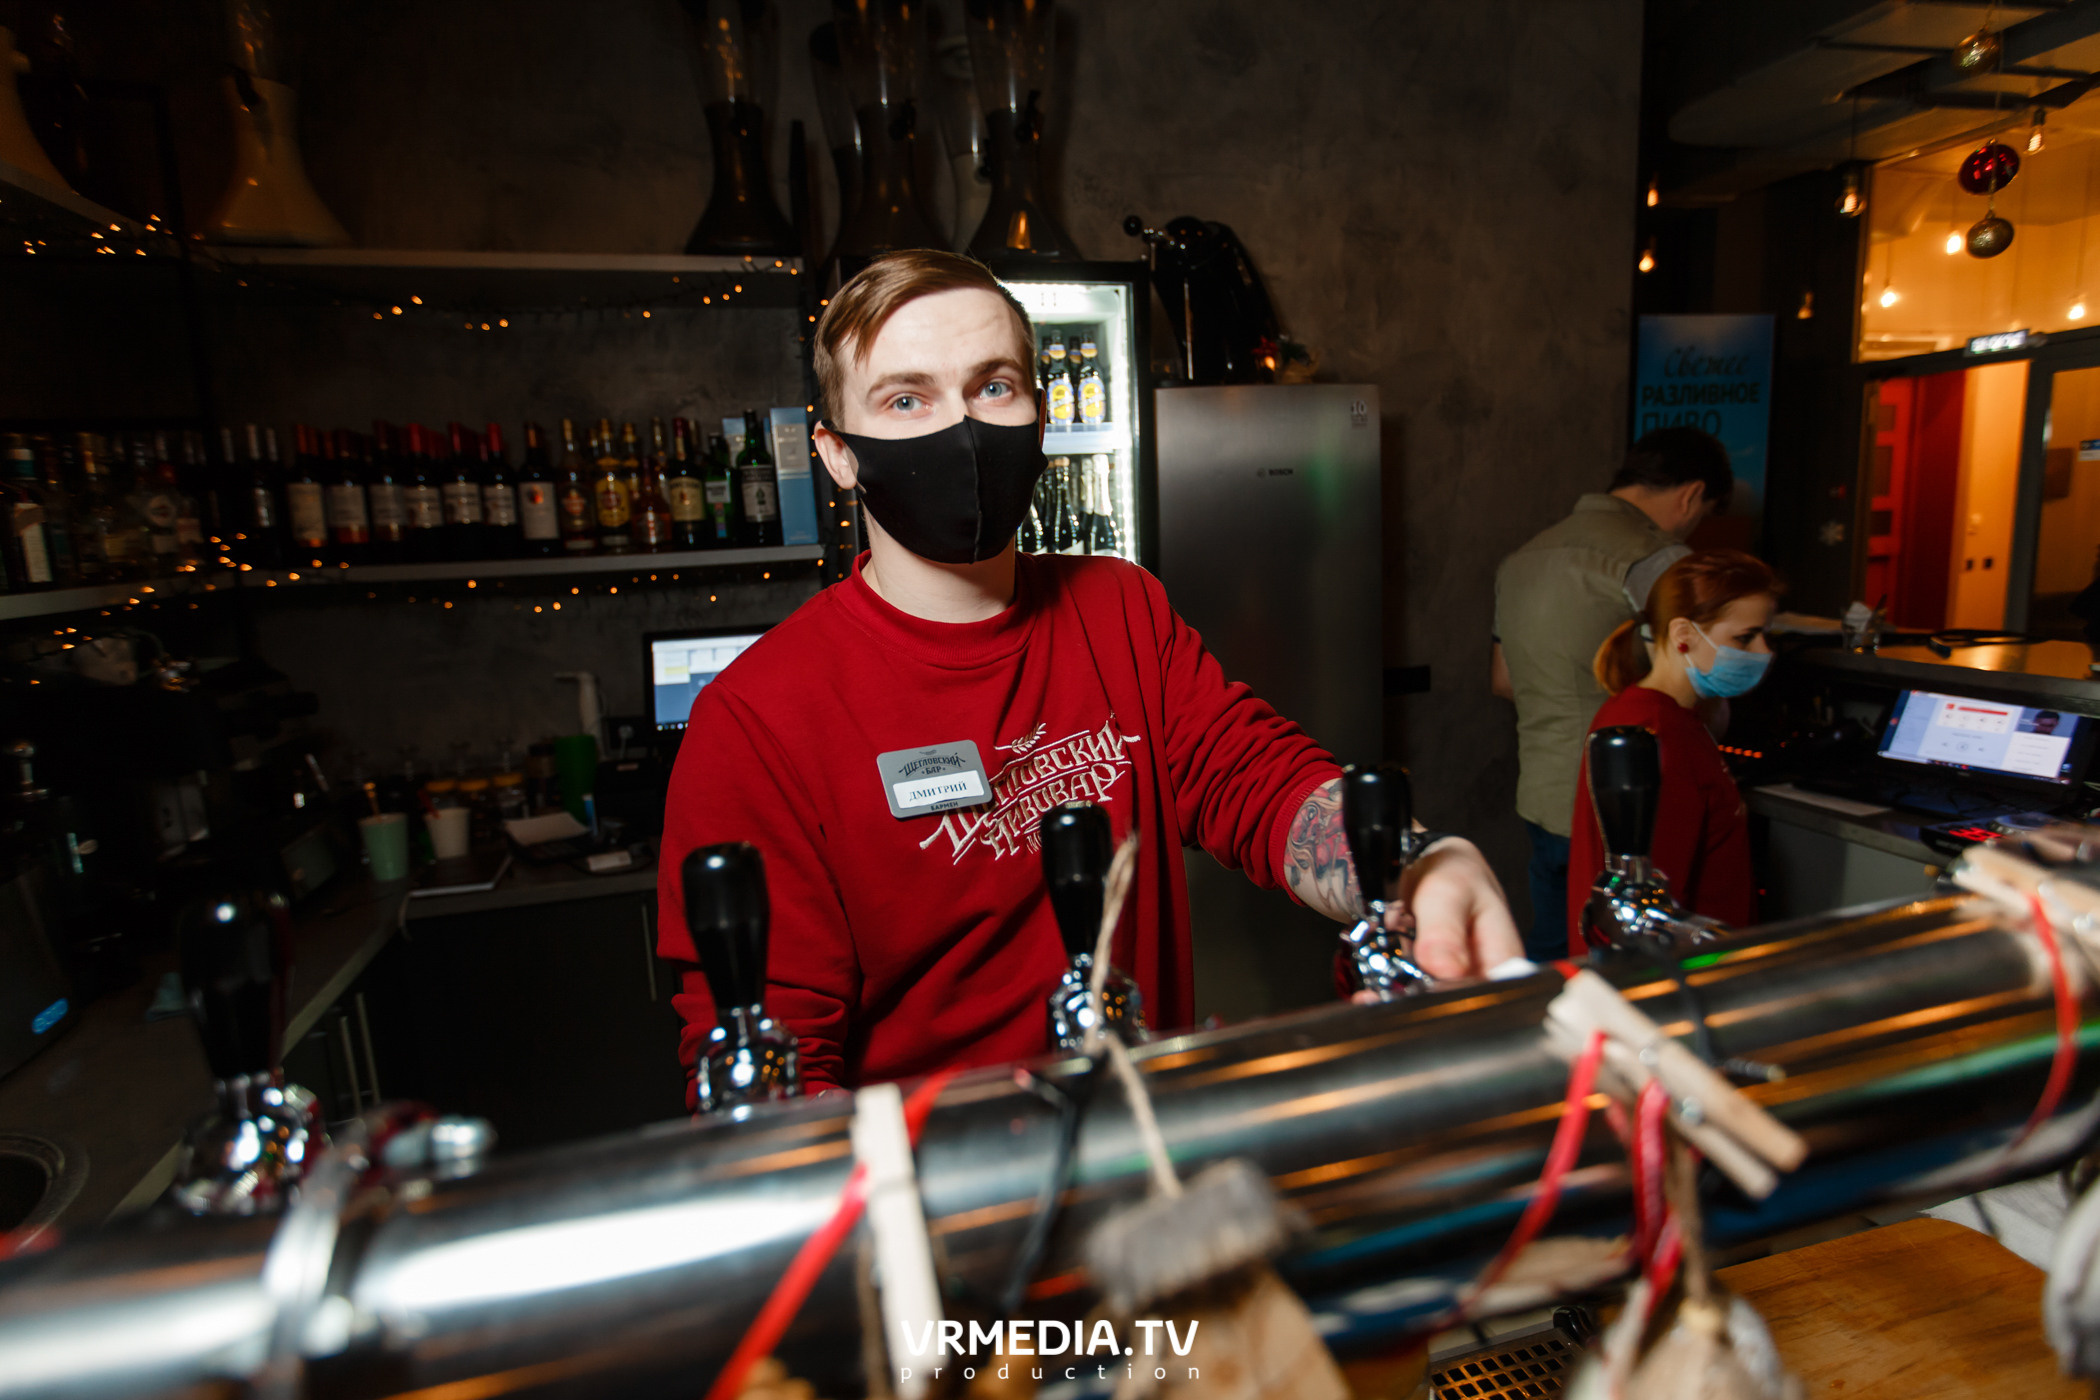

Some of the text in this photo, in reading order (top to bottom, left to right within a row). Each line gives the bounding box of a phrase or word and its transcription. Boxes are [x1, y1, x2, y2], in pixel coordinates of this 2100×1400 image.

[1641, 381, 1761, 407] РАЗЛИВНОЕ
[898, 752, 966, 777] ЩЕГЛОВСКИЙ
[926, 766, 942, 775] БАР
[909, 780, 968, 802] ДМИТРИЙ
[930, 801, 959, 811] БАРМЕН
